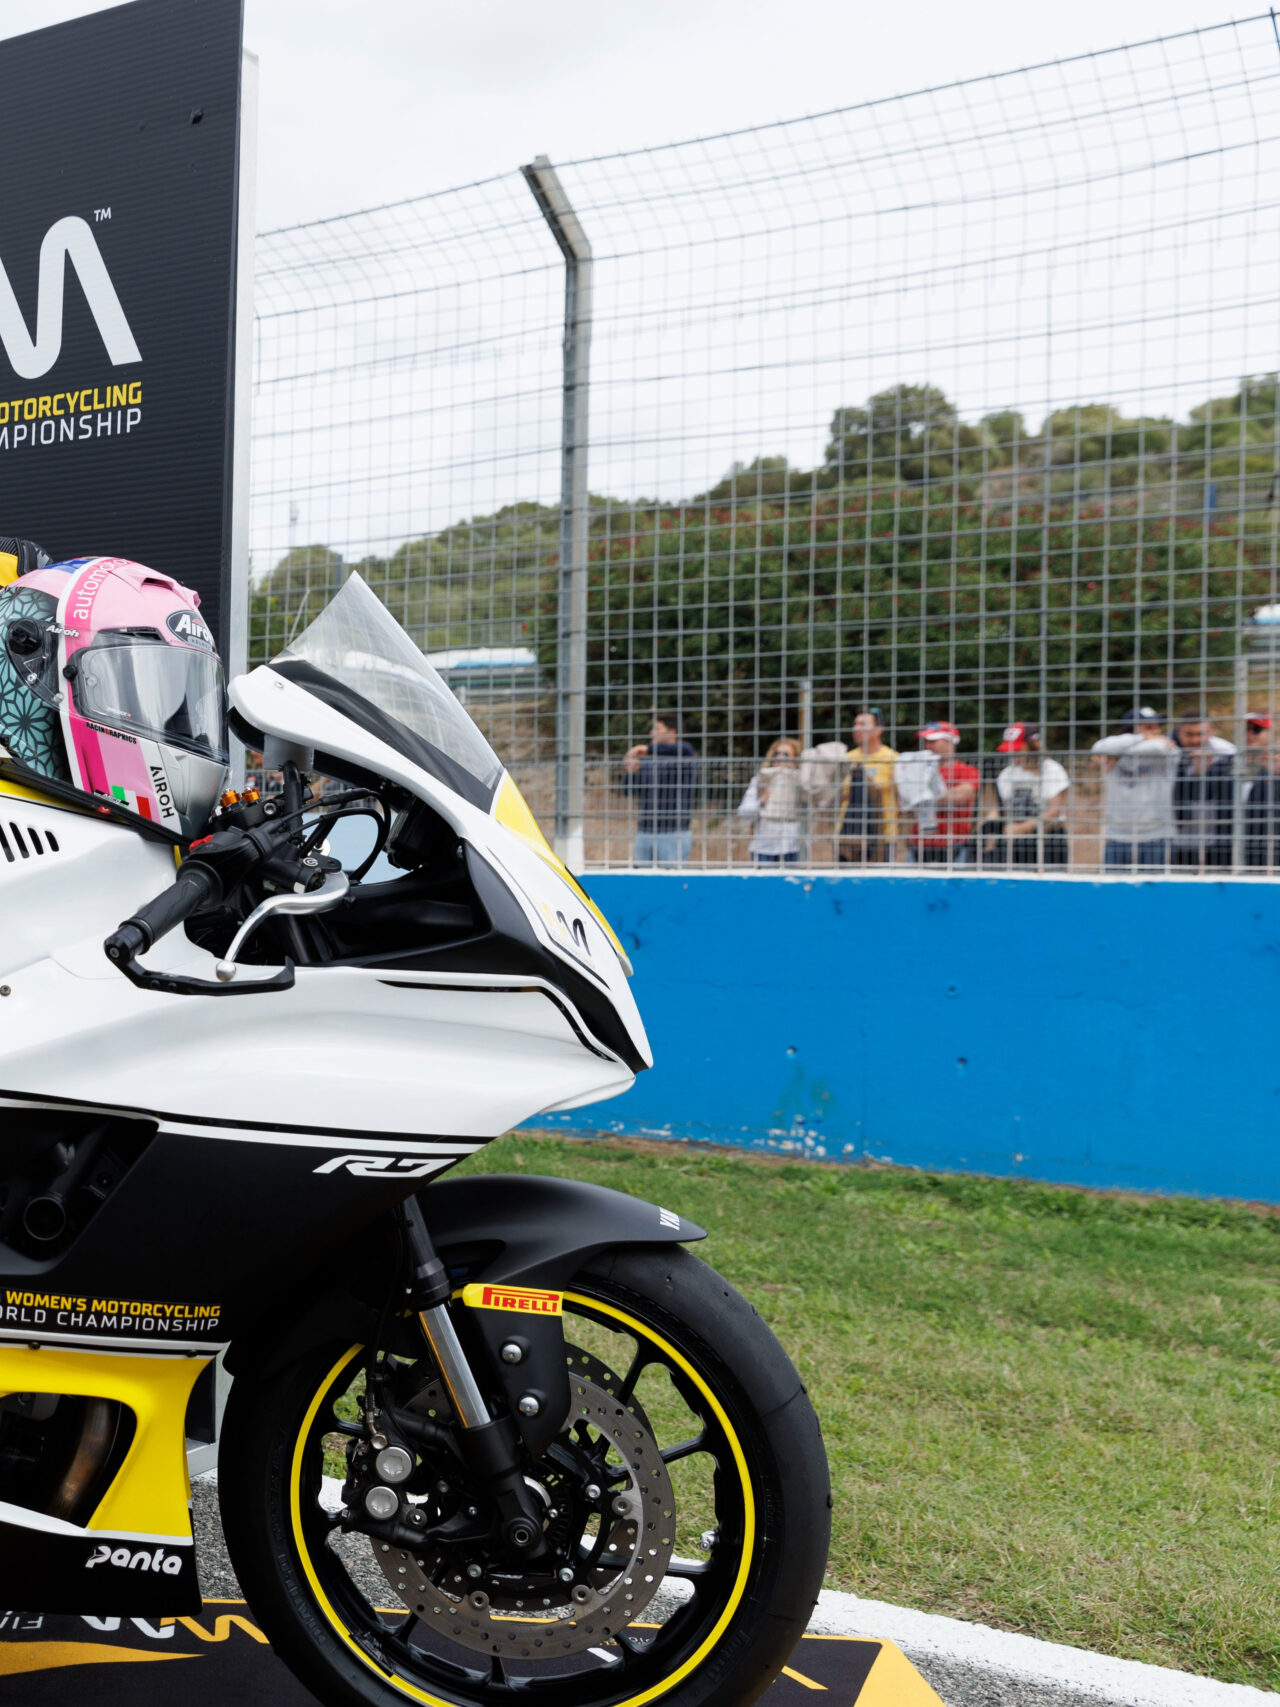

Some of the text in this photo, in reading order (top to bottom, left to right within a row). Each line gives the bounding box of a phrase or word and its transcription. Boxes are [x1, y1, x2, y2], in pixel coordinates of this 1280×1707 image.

[46, 625, 79, 637] Airoh
[150, 765, 175, 818] AIROH
[312, 1154, 458, 1178] R7
[6, 1290, 88, 1311] WOMEN'S
[91, 1300, 220, 1318] MOTORCYCLING
[482, 1287, 560, 1313] PIRELLI
[56, 1307, 220, 1332] CHAMPIONSHIP
[85, 1545, 183, 1575] panta
